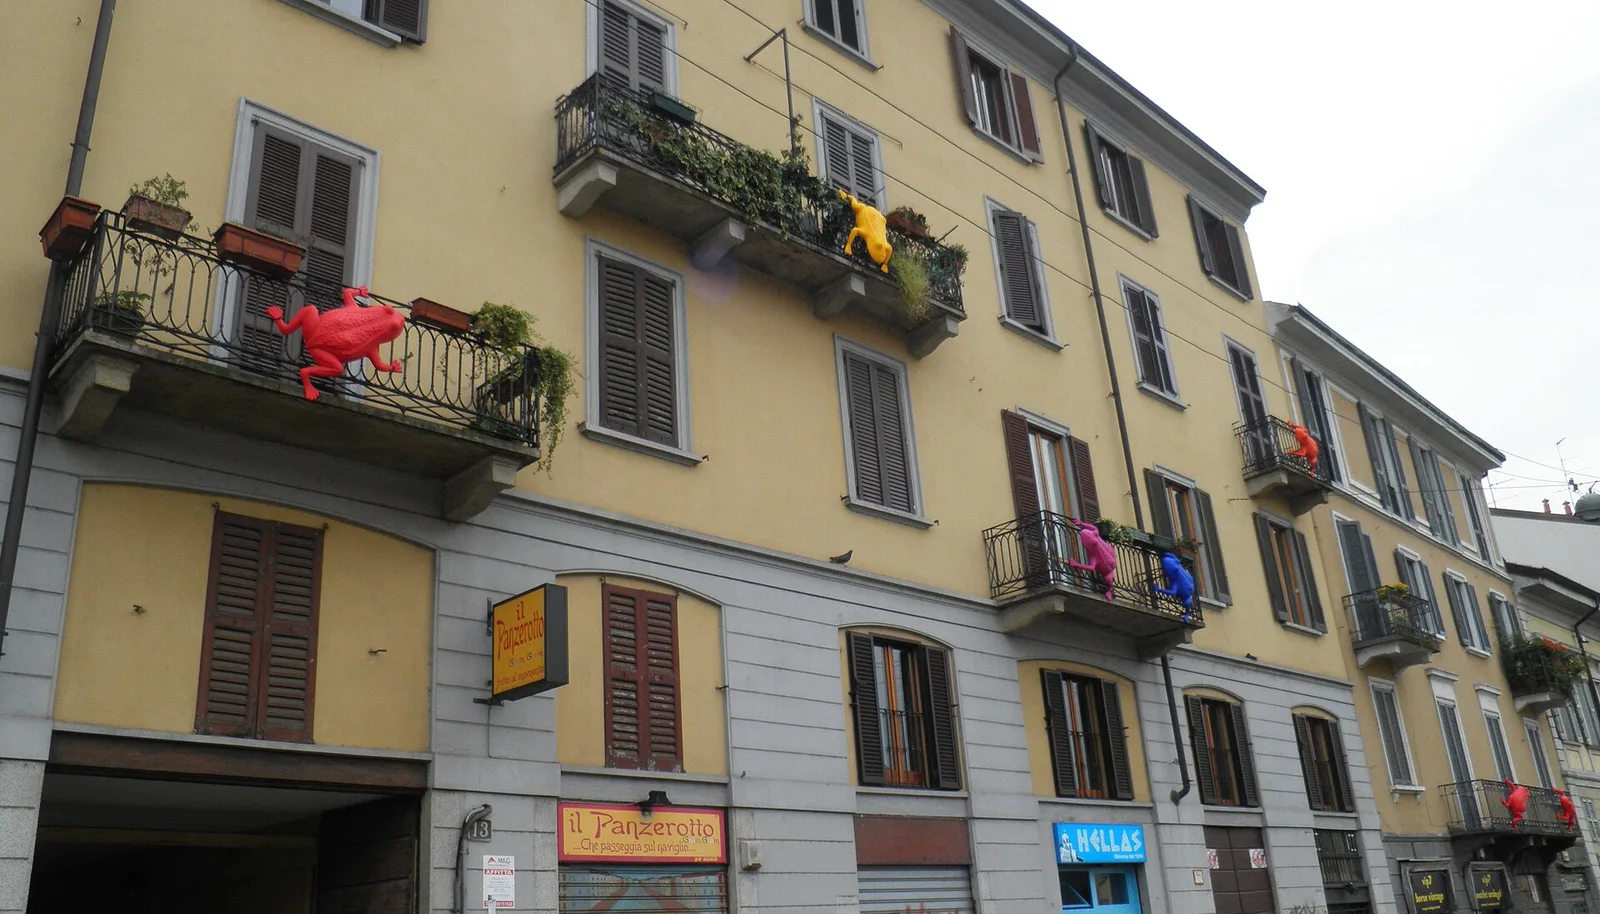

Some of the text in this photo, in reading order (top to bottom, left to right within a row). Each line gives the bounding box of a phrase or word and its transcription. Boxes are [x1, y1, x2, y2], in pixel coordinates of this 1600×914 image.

[516, 601, 525, 621] il
[496, 610, 544, 660] Panzerotto
[472, 822, 489, 838] 13
[569, 811, 714, 840] il Panzerotto
[601, 842, 642, 855] passeggia
[644, 841, 656, 853] sul
[1077, 828, 1142, 852] HELLAS
